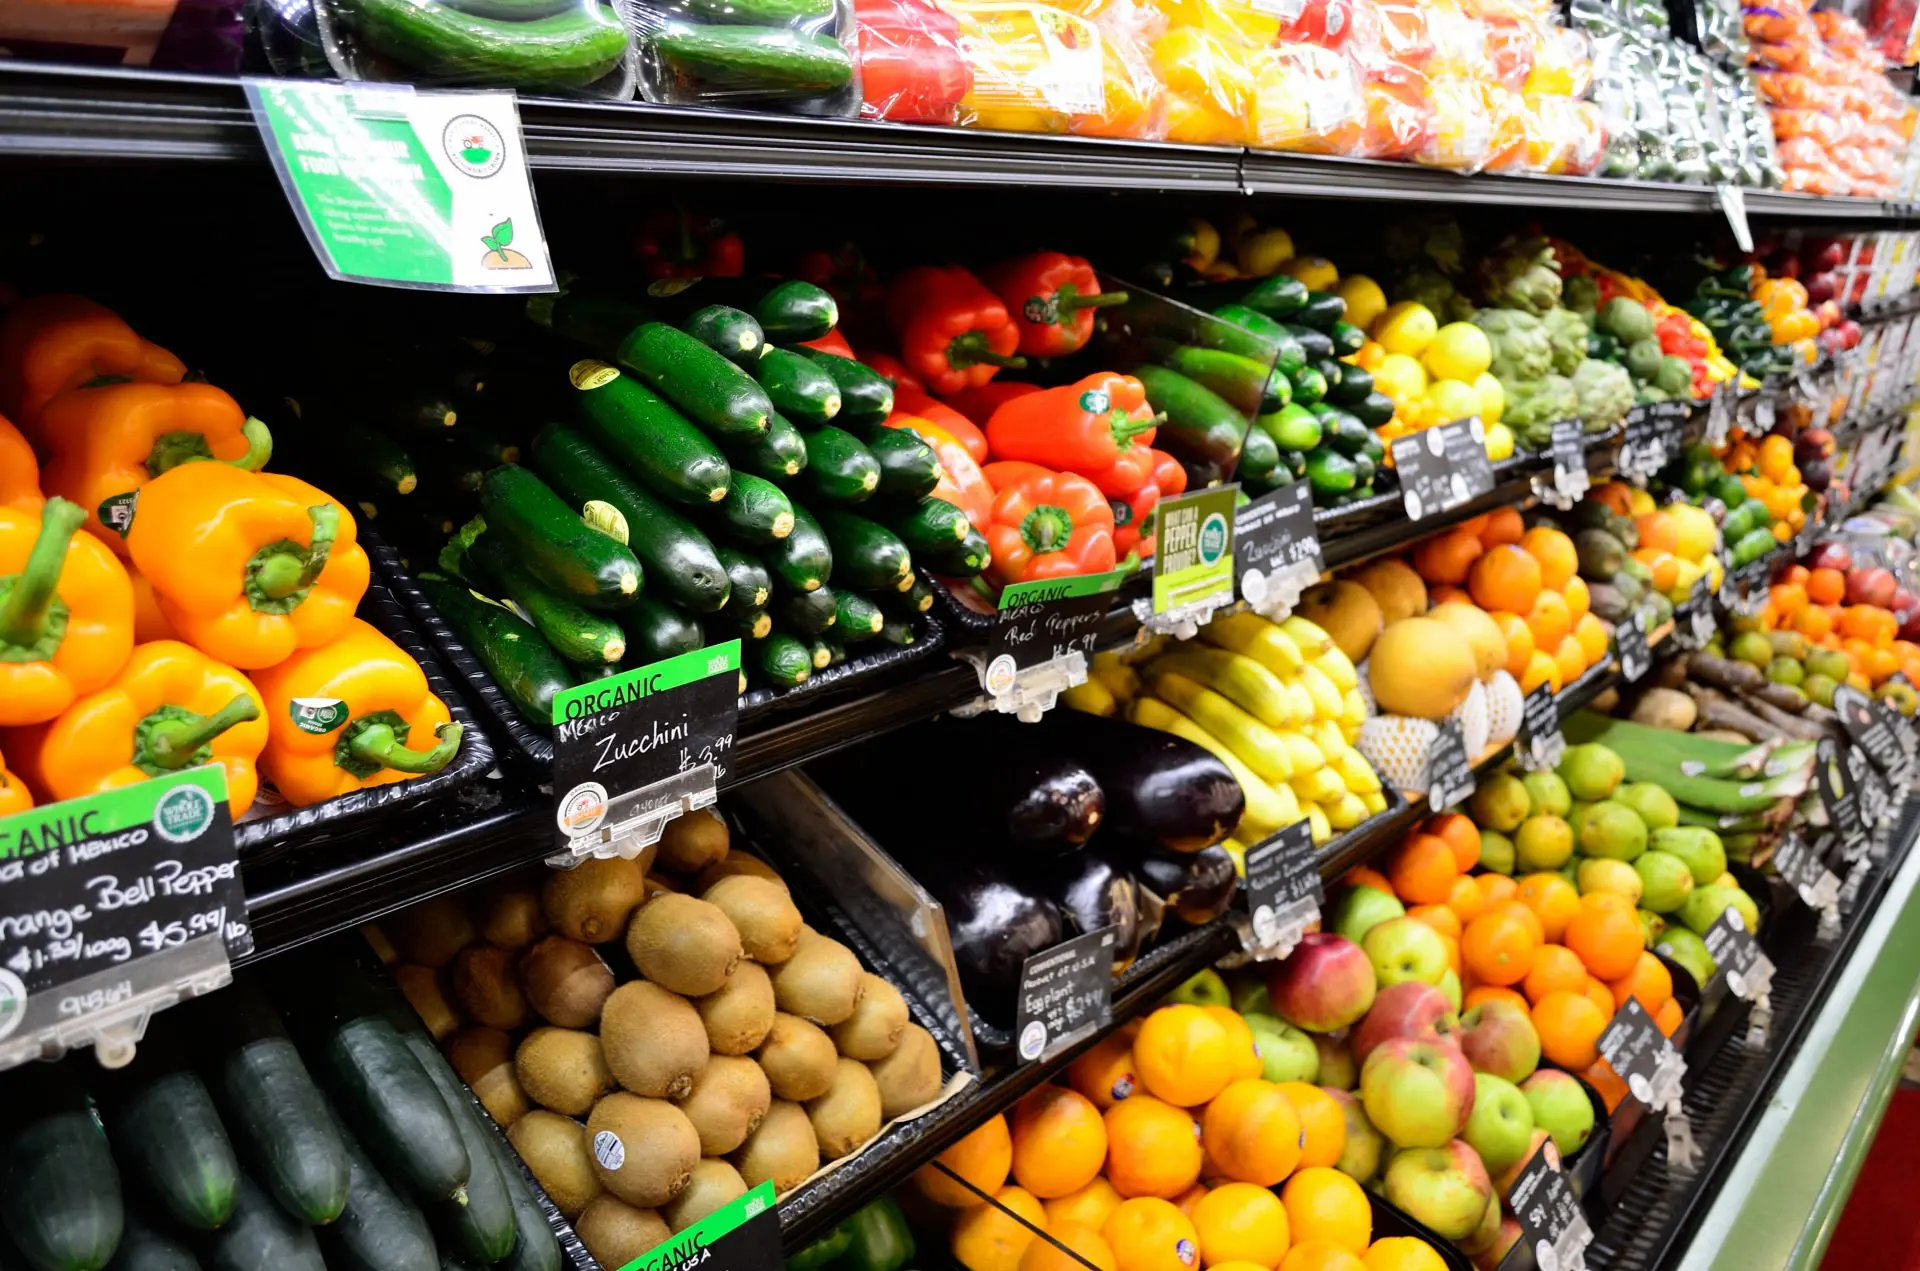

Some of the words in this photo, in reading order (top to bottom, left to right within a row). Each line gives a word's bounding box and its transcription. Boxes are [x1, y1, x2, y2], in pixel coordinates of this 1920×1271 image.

[1007, 585, 1072, 608] ORGANIC
[565, 673, 662, 721] ORGANIC
[593, 713, 689, 772] Zucchini
[85, 874, 155, 910] Bell
[153, 859, 240, 897] Pepper
